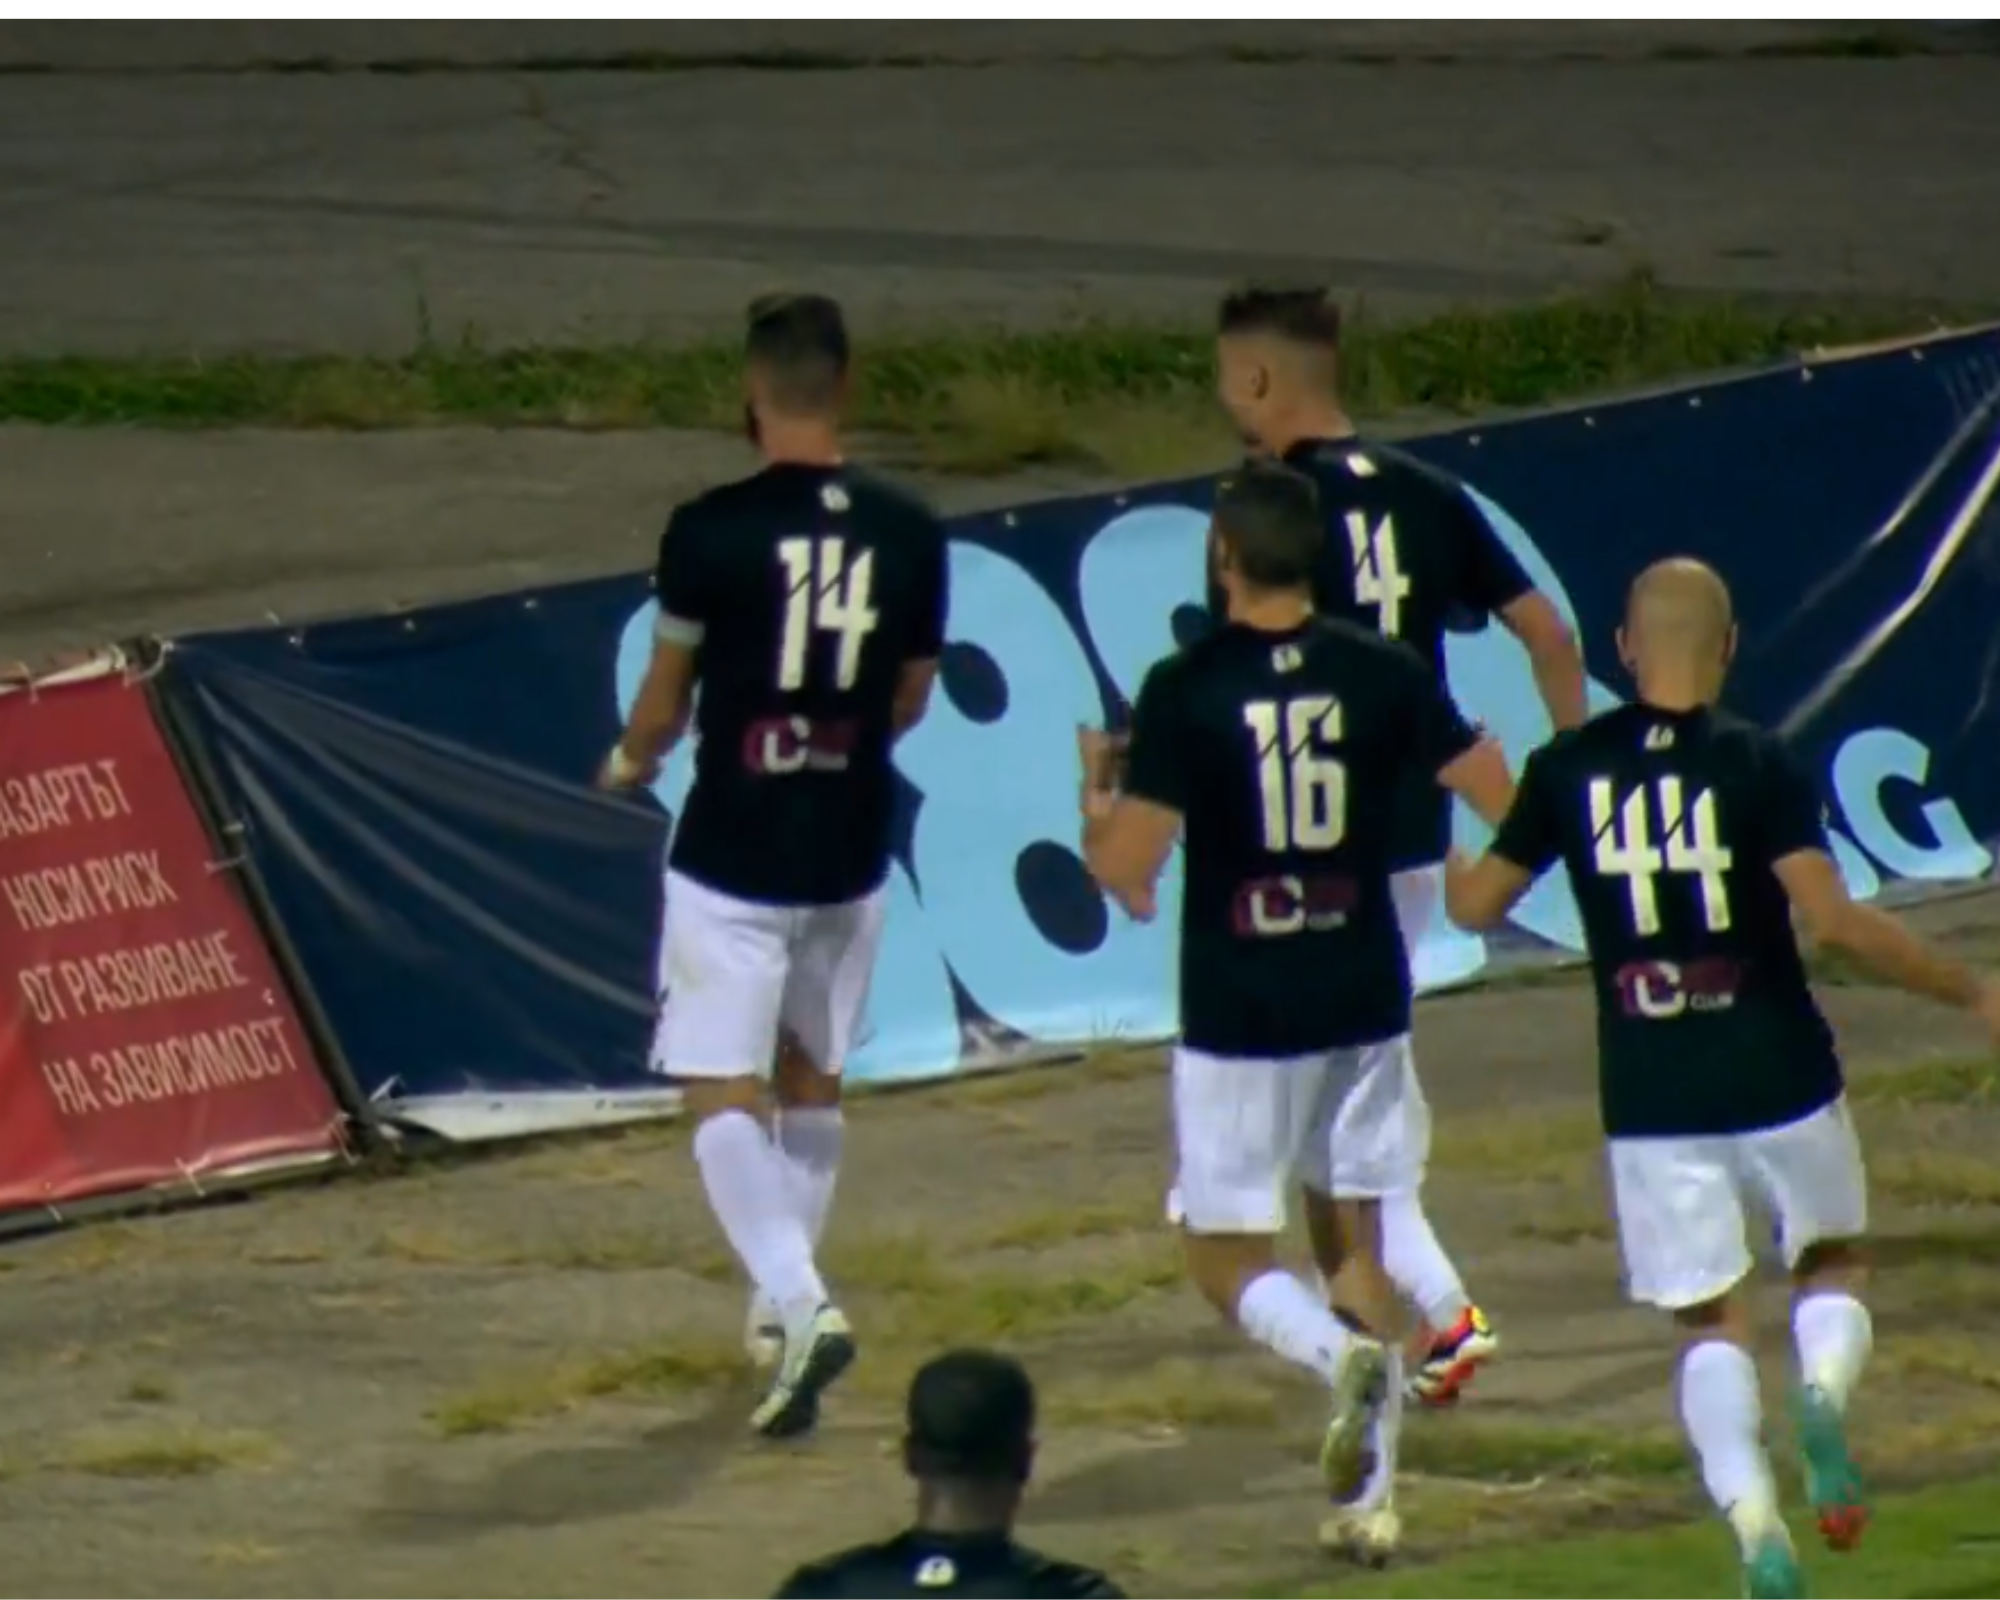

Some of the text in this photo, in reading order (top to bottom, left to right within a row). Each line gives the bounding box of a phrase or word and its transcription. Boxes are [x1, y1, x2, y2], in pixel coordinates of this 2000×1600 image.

[777, 537, 878, 691] 14
[1344, 510, 1410, 642] 4
[0, 758, 132, 839] АЗАРТЪТ
[1243, 696, 1346, 853] 16
[1, 849, 178, 932] НОСИ РИСК
[1589, 776, 1732, 936] 44
[18, 929, 249, 1023] ОТ РАЗВИВАНЕ
[42, 1015, 297, 1114] НА ЗАВИСИМОСТ
